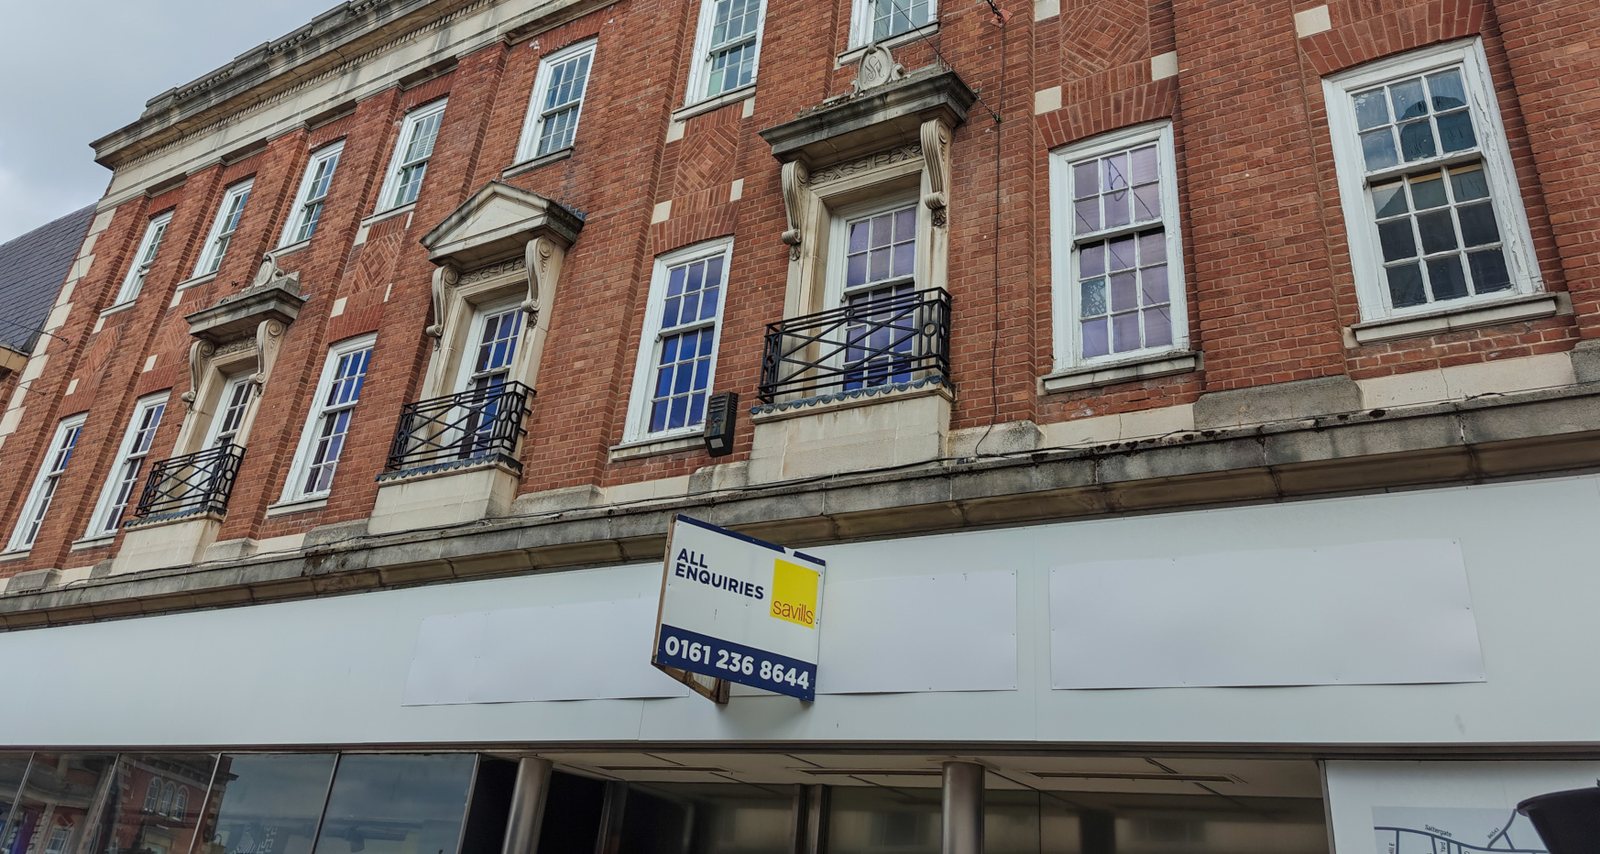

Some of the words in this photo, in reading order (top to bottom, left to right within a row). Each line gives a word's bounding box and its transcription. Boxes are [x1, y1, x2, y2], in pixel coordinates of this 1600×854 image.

[676, 548, 708, 569] ALL
[675, 562, 764, 600] ENQUIRIES
[773, 600, 814, 625] savills
[665, 636, 711, 665] 0161
[715, 649, 755, 676] 236
[760, 661, 810, 690] 8644
[1425, 824, 1452, 838] Saltergate
